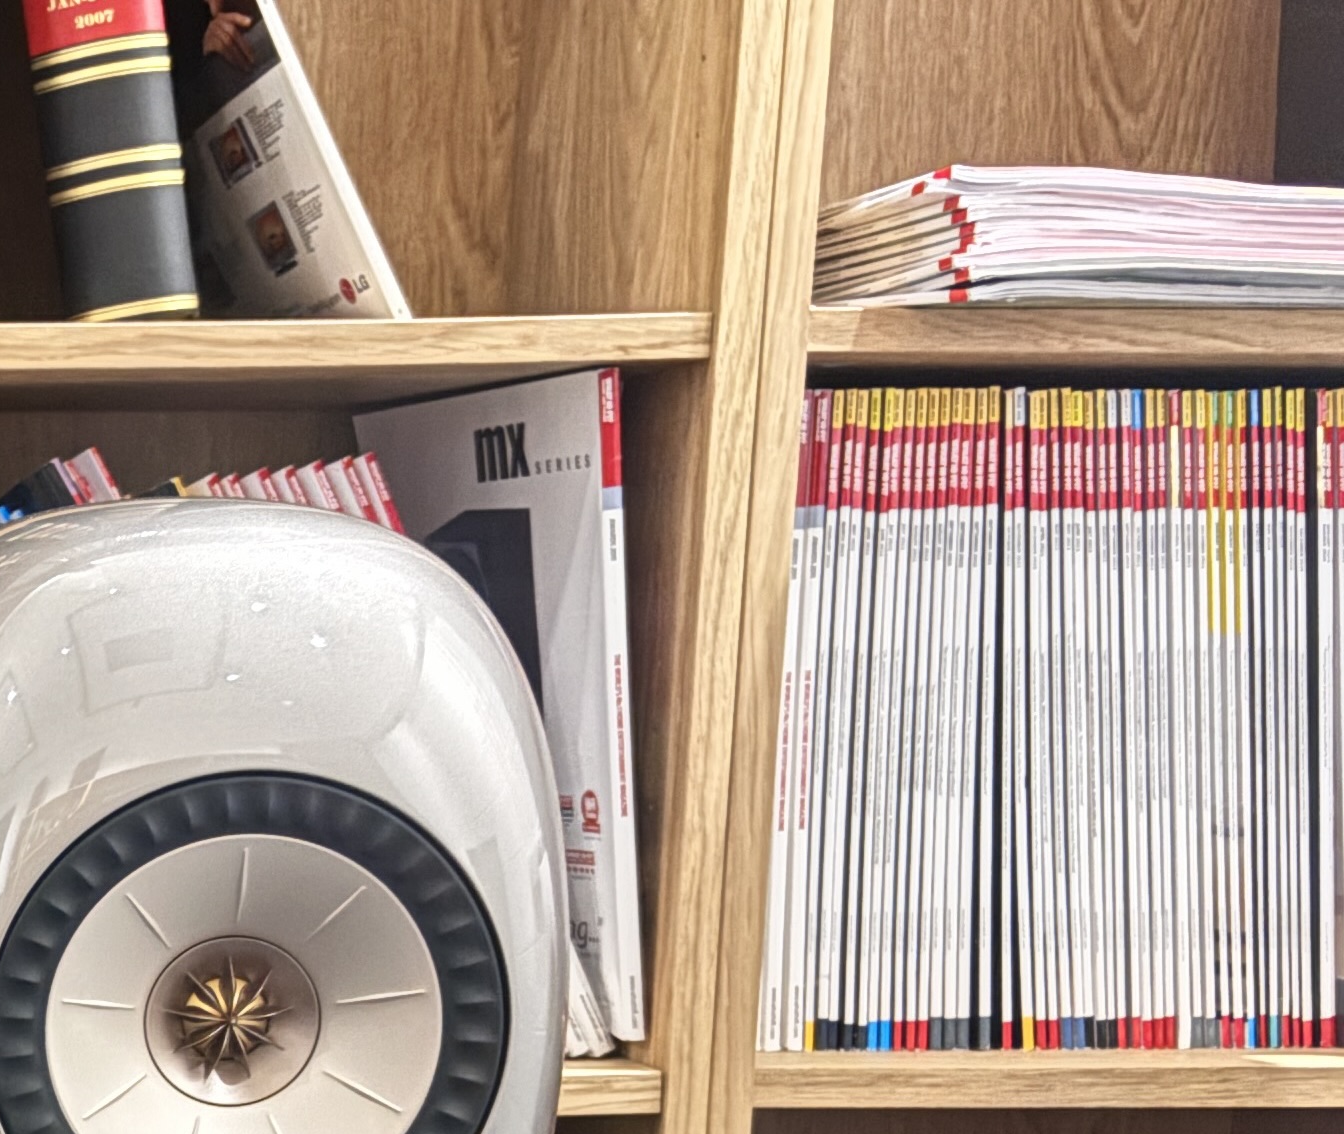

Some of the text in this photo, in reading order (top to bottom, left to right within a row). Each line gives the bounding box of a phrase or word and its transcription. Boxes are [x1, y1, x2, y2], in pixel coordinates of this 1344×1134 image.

[74, 9, 115, 30] 2007
[353, 274, 370, 293] LG
[534, 453, 591, 475] SERIES
